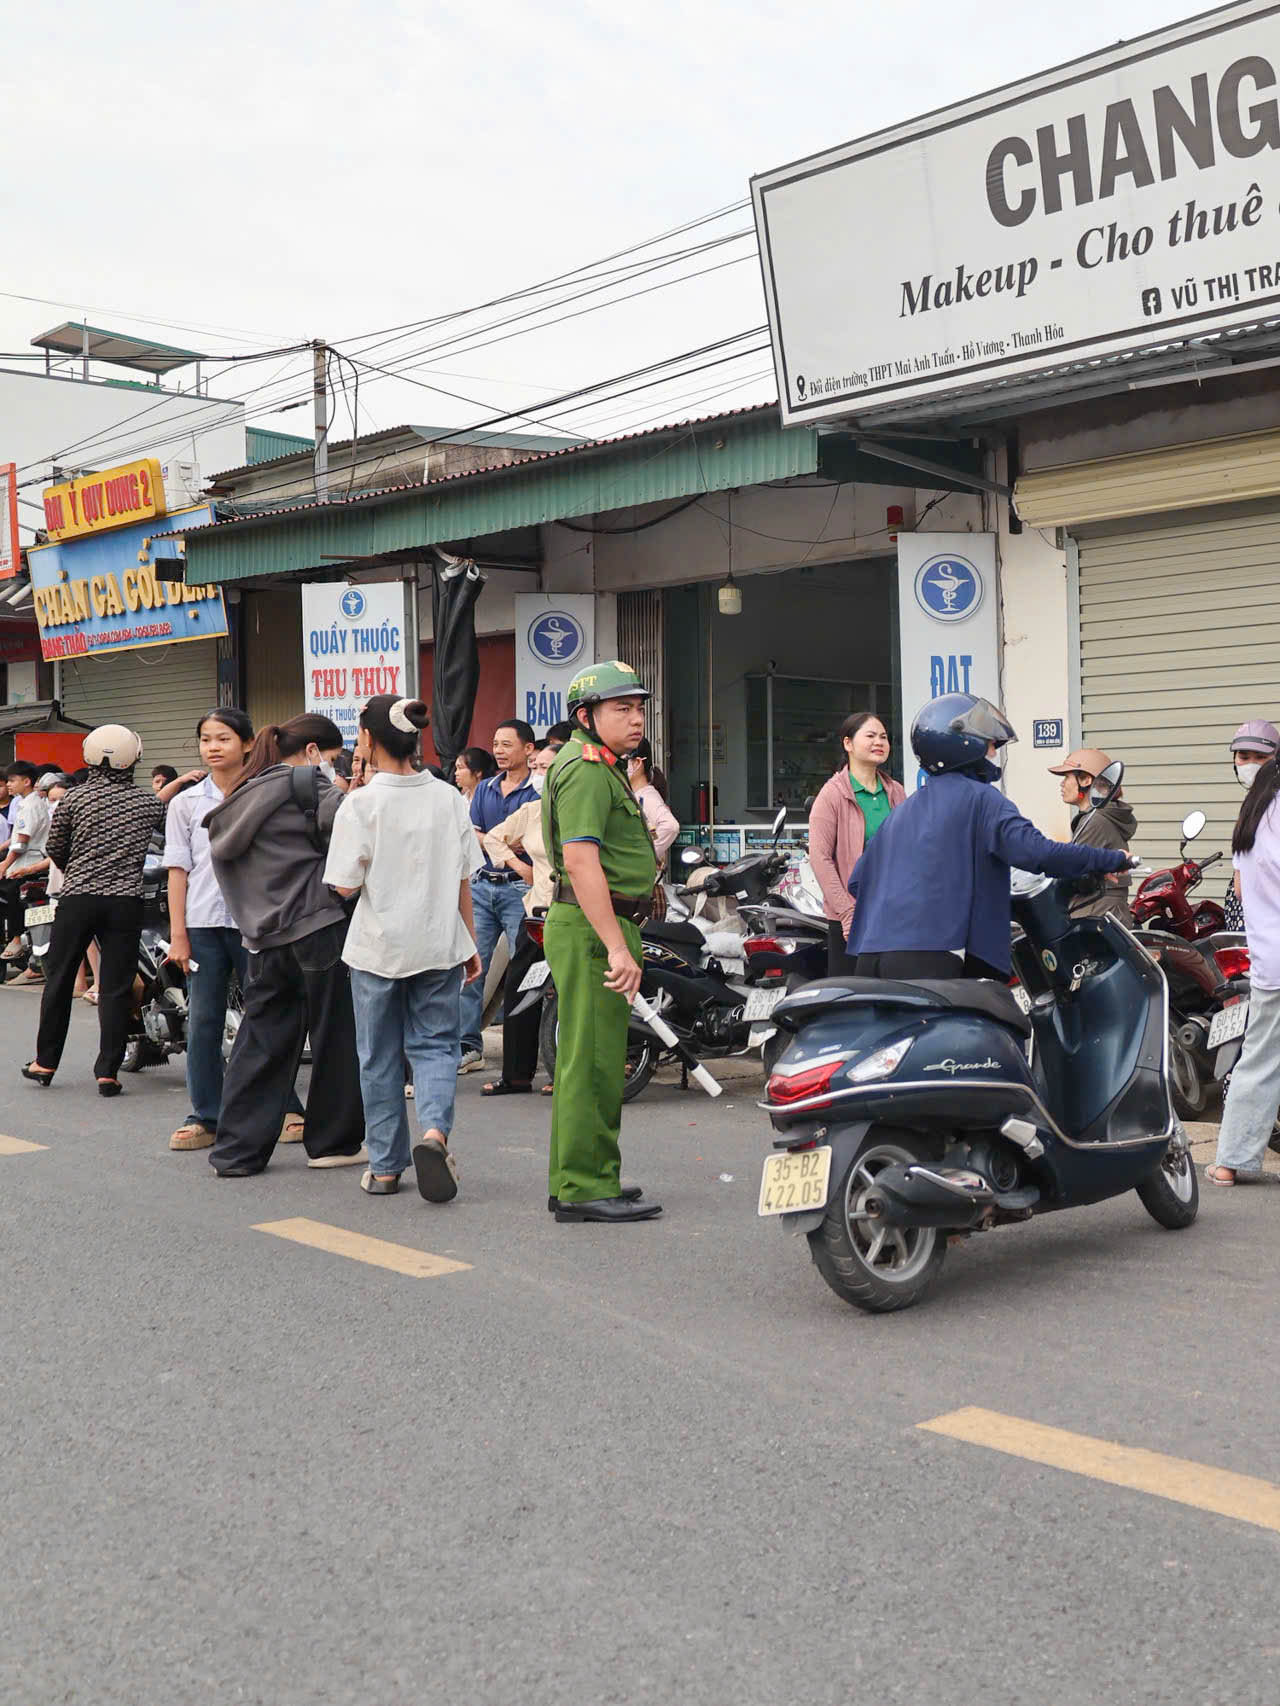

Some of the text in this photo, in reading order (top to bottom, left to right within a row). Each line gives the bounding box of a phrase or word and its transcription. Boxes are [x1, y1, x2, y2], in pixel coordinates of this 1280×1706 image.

[899, 256, 1039, 318] Makeup
[1076, 221, 1154, 269] Cho
[1168, 183, 1264, 247] thuê
[1171, 278, 1198, 310] VŨ
[1203, 272, 1240, 302] THỊ
[868, 363, 892, 382] THPT
[895, 358, 912, 376] Mai
[913, 356, 931, 372] Anh
[931, 346, 955, 368] Tuấn
[976, 339, 1004, 356] Vương
[1011, 328, 1042, 349] Thanh
[140, 470, 152, 507] 2
[91, 572, 125, 617] GA
[352, 618, 400, 653] THUỐC
[312, 654, 400, 698] THU THỦY
[526, 683, 561, 727] BÁN
[1038, 723, 1057, 738] 139
[923, 1057, 1002, 1075] Grande
[773, 1152, 820, 1182] 35-B2
